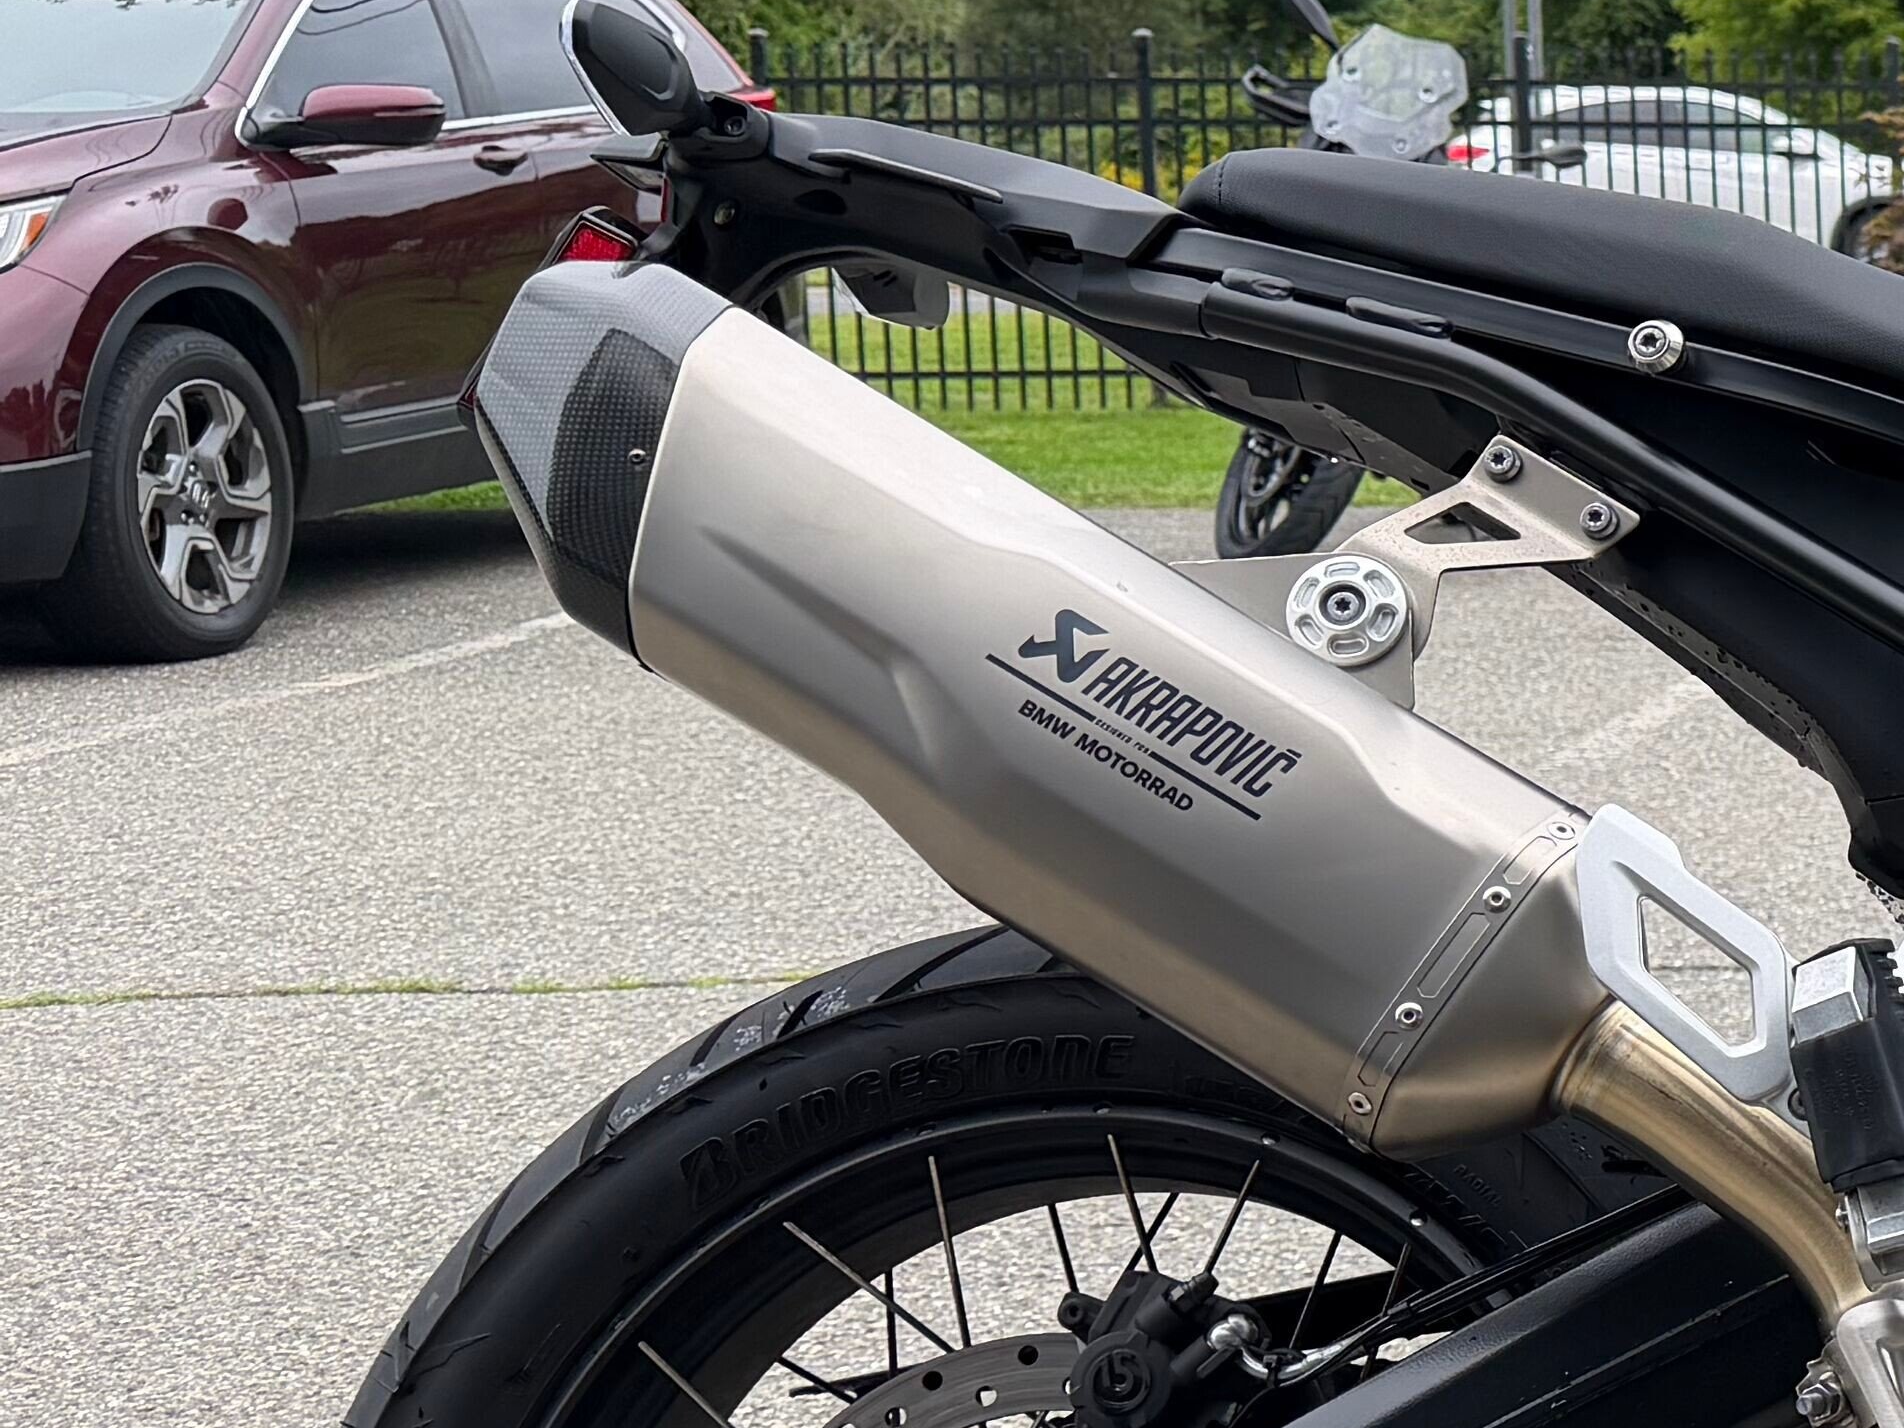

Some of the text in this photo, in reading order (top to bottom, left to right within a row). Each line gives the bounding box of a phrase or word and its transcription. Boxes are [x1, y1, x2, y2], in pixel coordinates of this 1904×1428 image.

[1018, 699, 1194, 811] BMW MOTORRAD
[680, 1033, 1136, 1210] BRIDGESTONE
